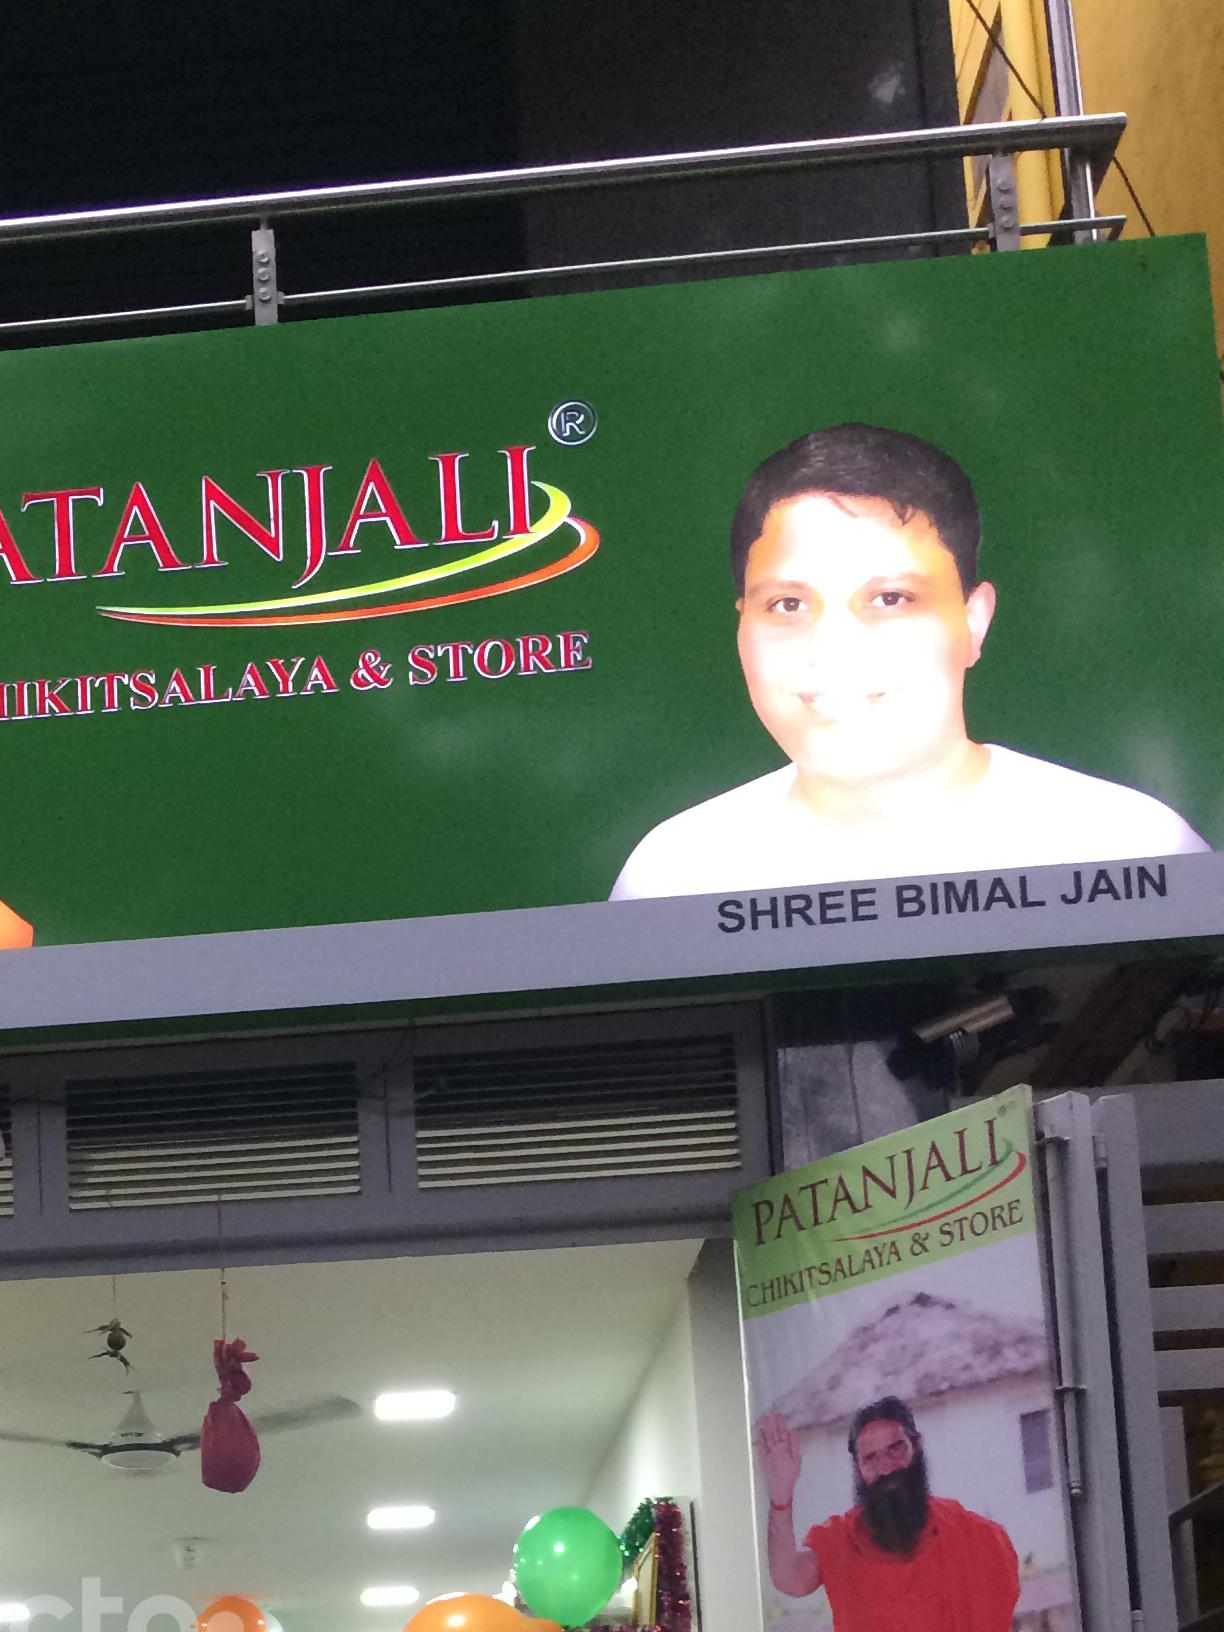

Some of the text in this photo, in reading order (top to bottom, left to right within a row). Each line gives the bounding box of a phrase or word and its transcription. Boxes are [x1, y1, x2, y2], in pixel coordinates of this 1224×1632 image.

[349, 649, 394, 690] &
[407, 631, 593, 688] STORE
[717, 863, 1168, 934] SHREE BIMAL JAIN
[752, 1117, 998, 1246] PATANJALI
[745, 1199, 1024, 1308] CHIKITSALAYA & STORE
